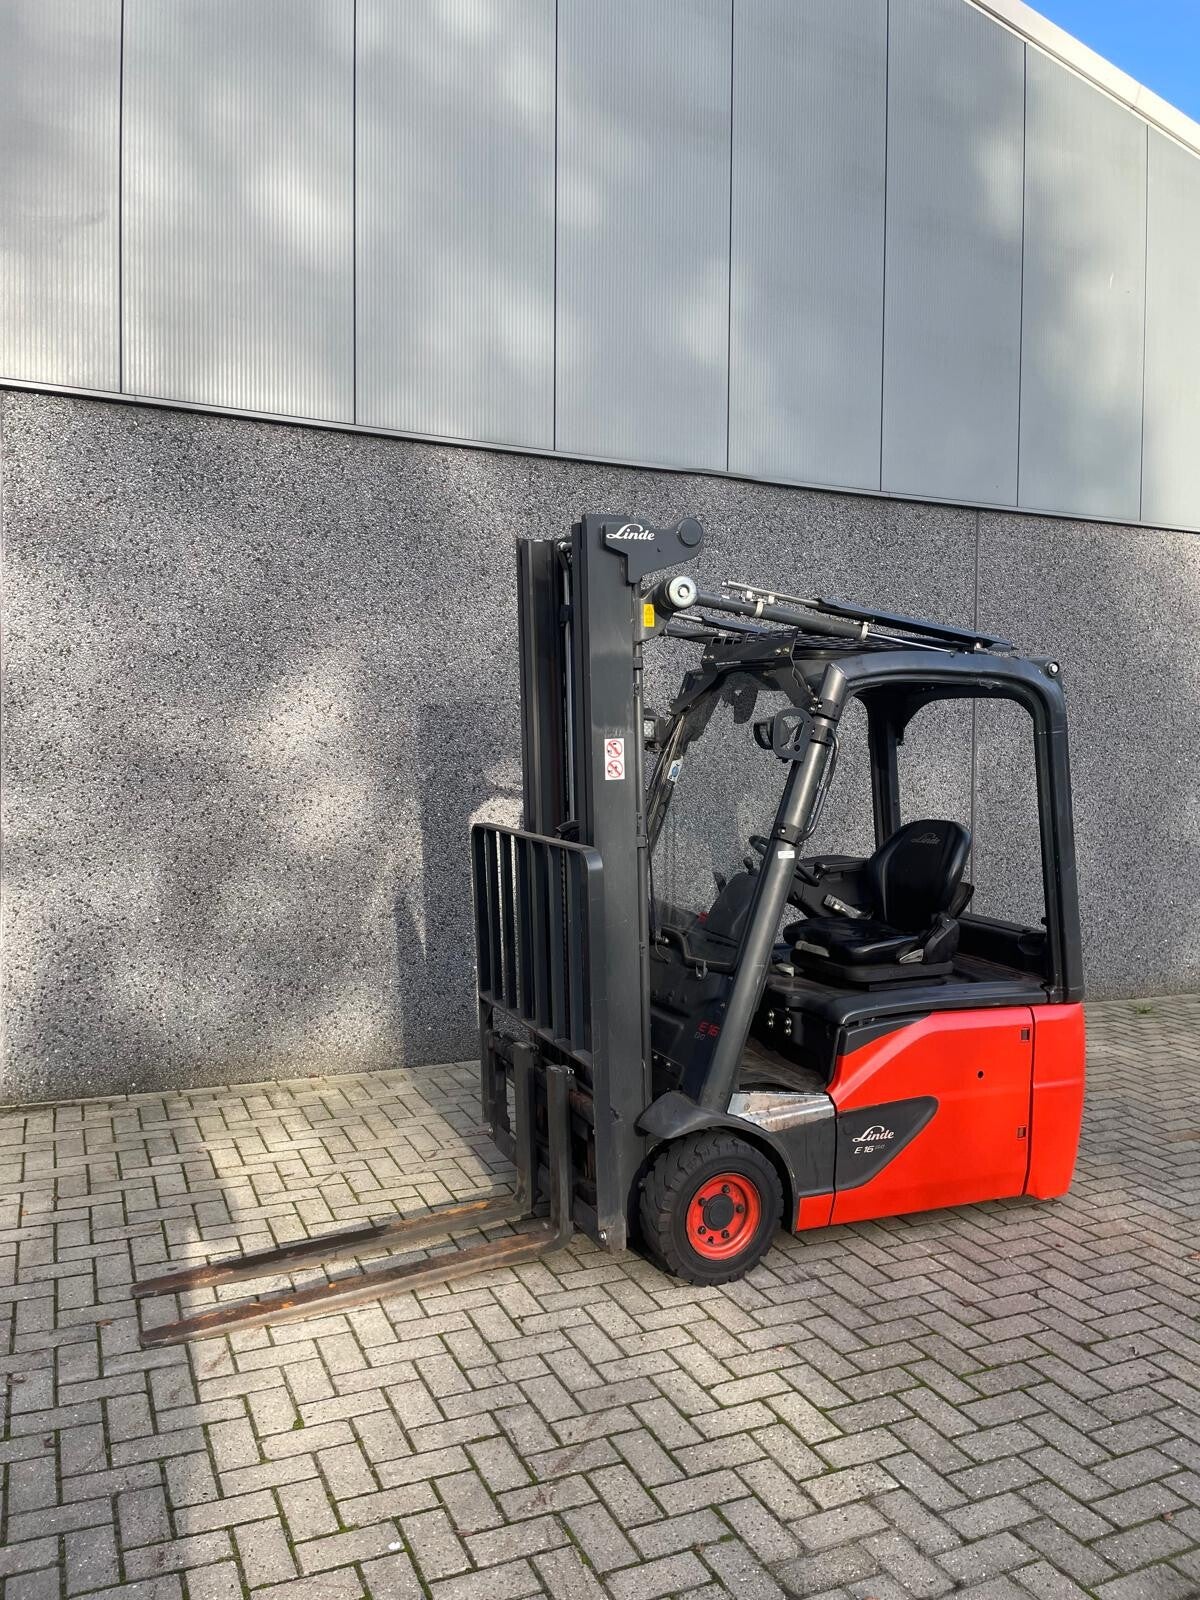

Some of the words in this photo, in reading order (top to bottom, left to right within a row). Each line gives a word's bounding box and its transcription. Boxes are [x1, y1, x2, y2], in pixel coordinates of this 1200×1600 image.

[606, 523, 656, 541] Linde
[852, 1125, 895, 1143] Linde
[854, 1146, 864, 1154] E
[863, 1145, 875, 1153] 16
